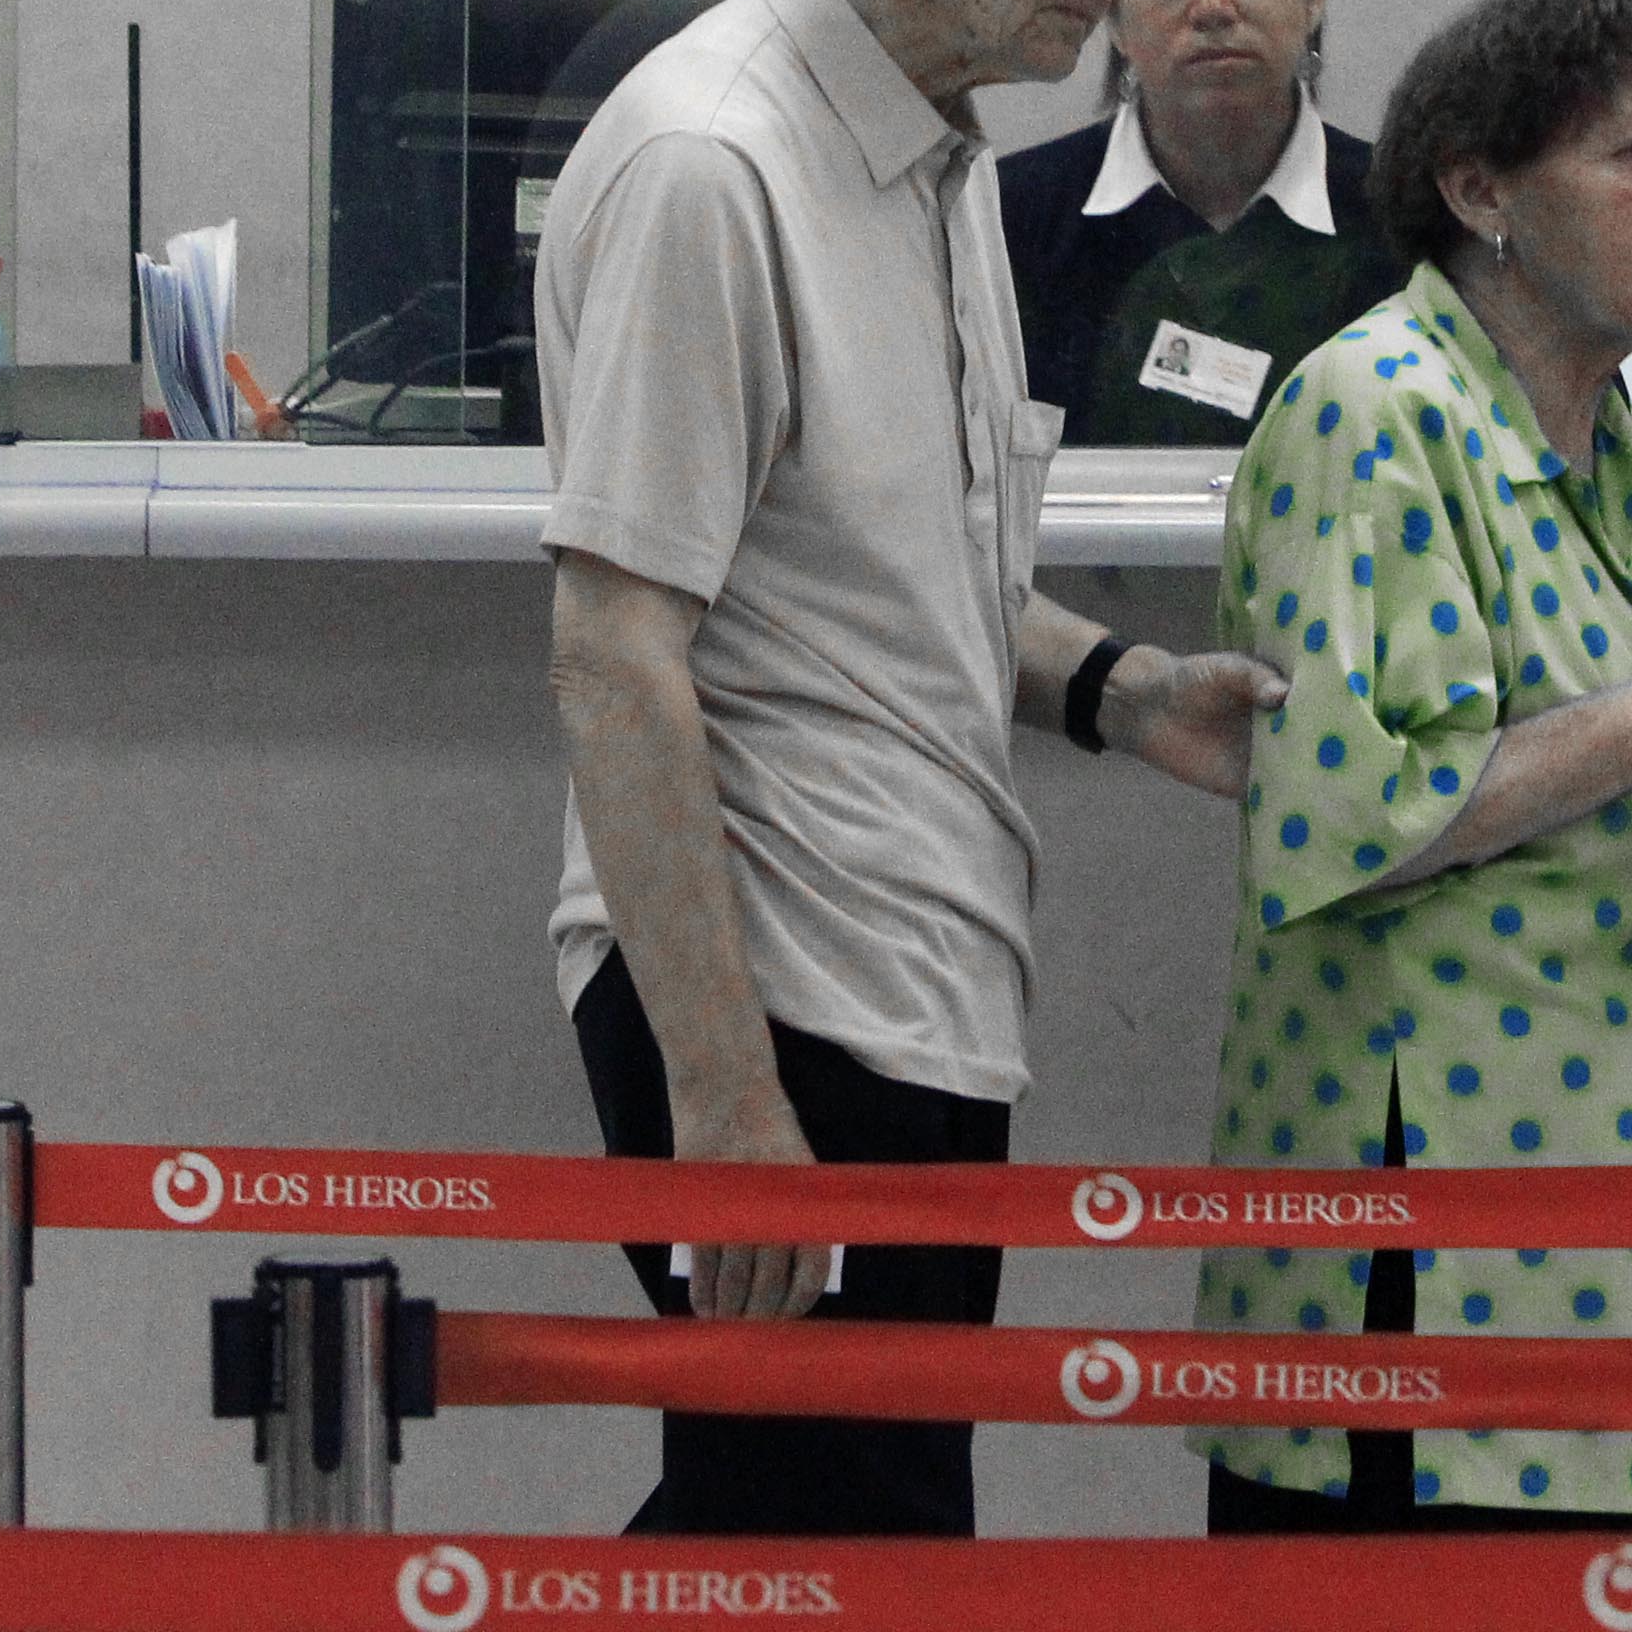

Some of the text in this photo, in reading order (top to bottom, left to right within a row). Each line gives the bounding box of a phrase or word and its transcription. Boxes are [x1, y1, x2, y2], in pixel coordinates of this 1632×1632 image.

[233, 1173, 310, 1207] LOS
[1152, 1193, 1230, 1225] LOS
[1149, 1362, 1237, 1401] LOS
[500, 1571, 602, 1613] LOS
